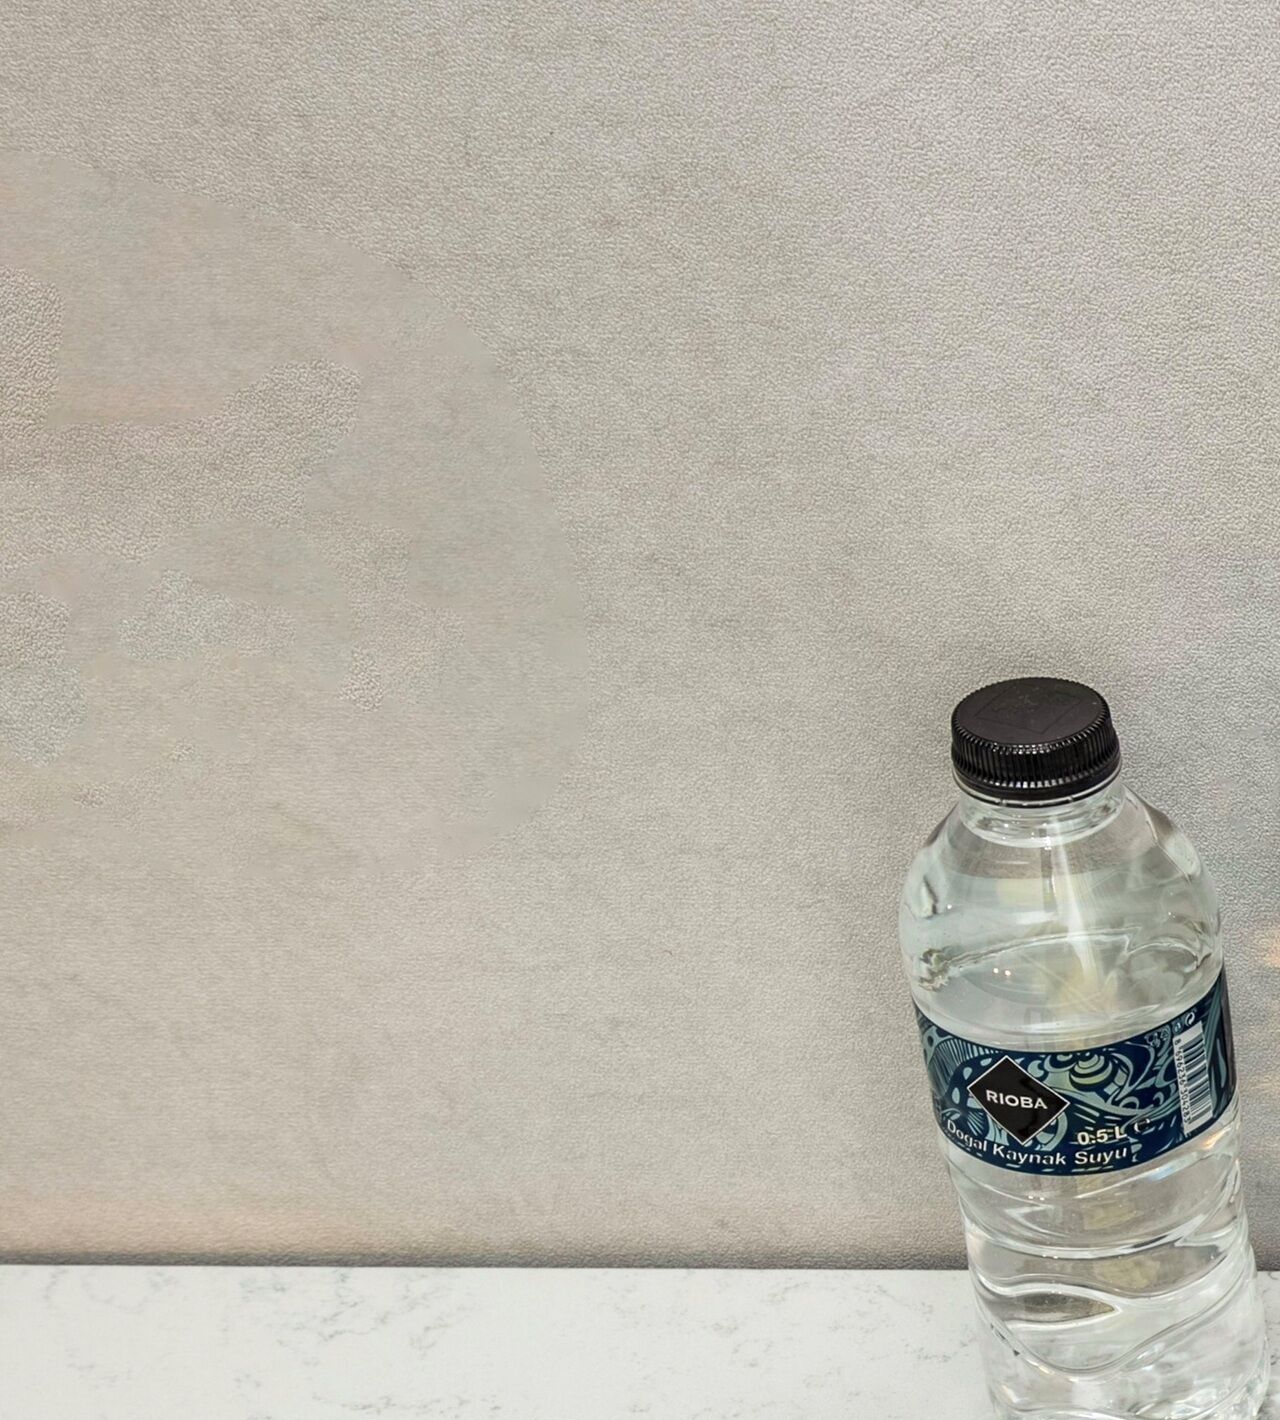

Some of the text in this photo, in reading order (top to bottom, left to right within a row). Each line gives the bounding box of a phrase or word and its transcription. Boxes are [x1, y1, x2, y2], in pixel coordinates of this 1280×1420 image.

[985, 1089, 1048, 1109] RIOBA
[1077, 1126, 1128, 1146] 0.5 L
[992, 1143, 1067, 1166] Kaynak
[1074, 1147, 1128, 1165] Suyu
